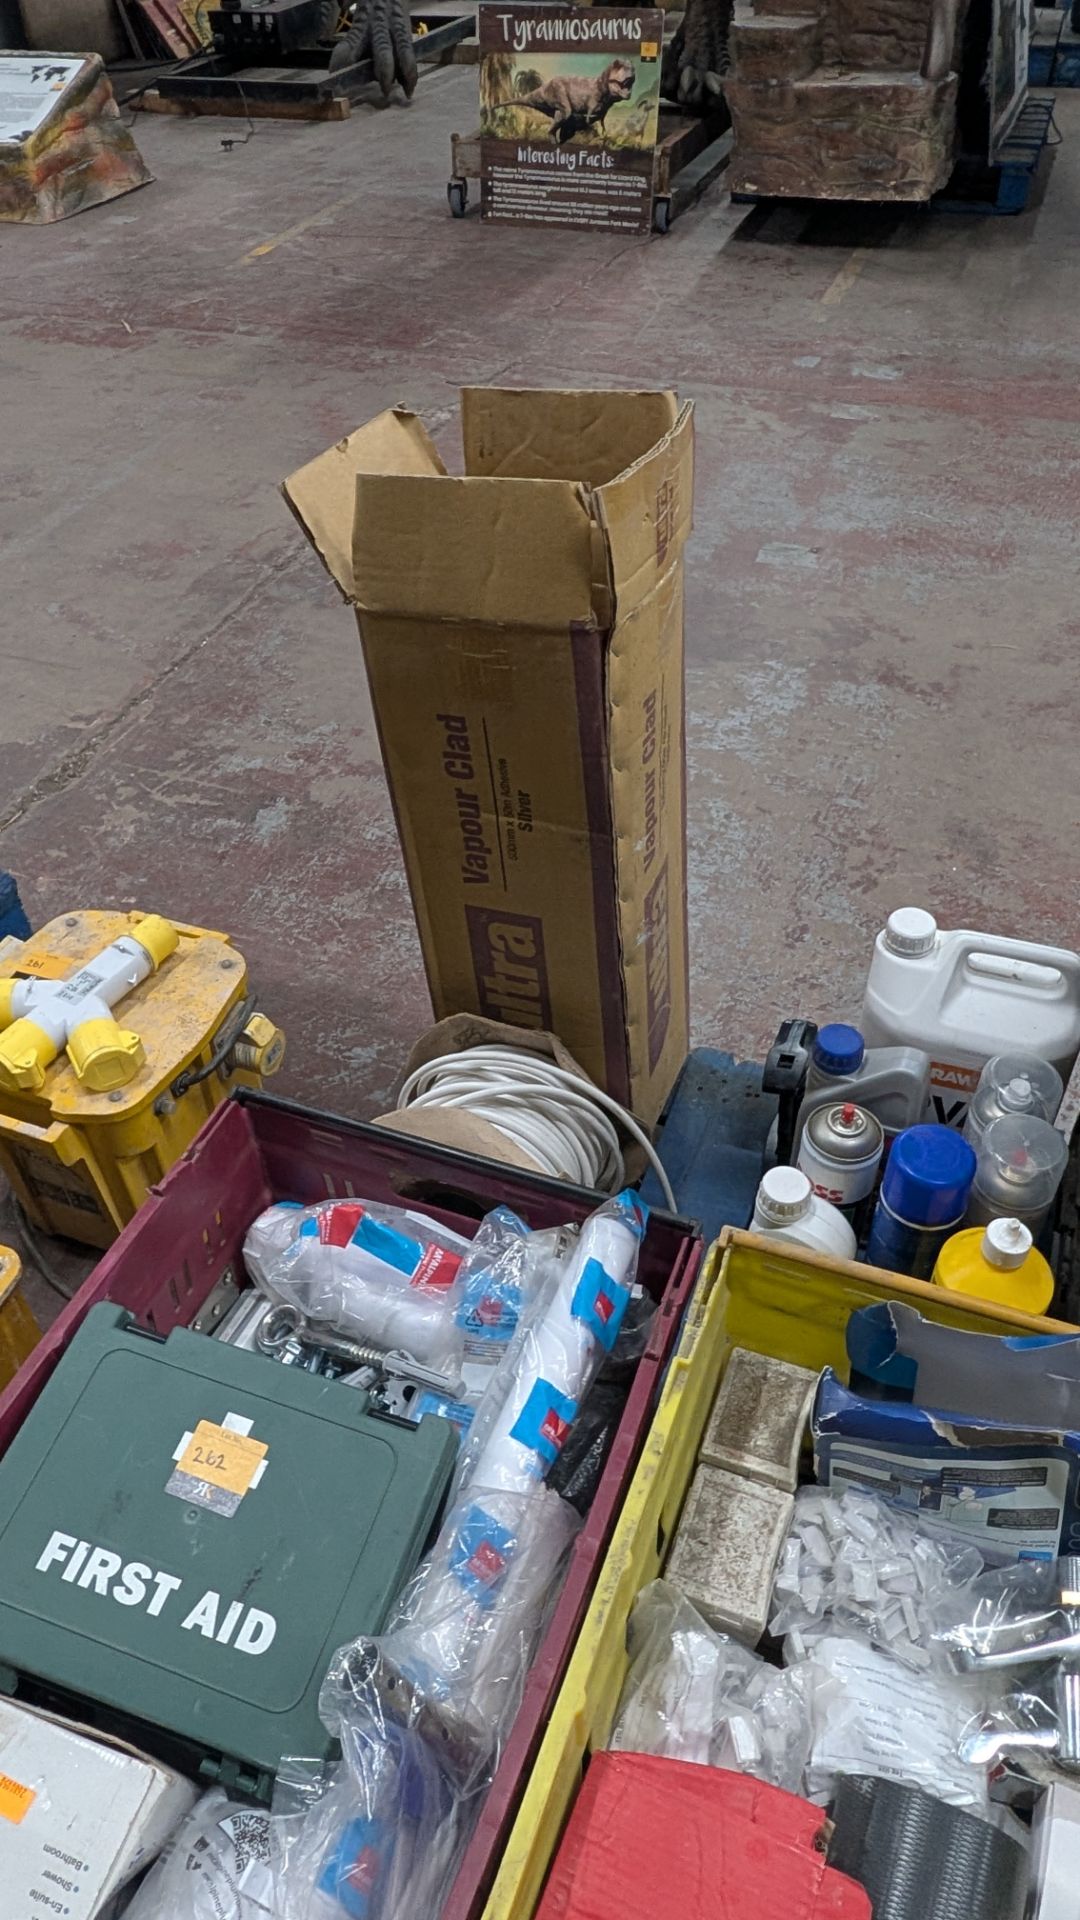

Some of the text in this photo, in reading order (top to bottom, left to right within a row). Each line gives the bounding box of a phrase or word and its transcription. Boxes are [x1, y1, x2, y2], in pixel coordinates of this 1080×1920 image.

[496, 13, 642, 51] Tyrannosaurus
[517, 146, 577, 170] Interesting
[641, 688, 658, 874] Vapour Clad
[436, 713, 490, 887] Vapour Clad
[517, 789, 534, 833] Silver
[192, 1446, 227, 1471] 262
[34, 1530, 277, 1656] FIRST AID
[42, 1843, 83, 1871] Bathroom
[41, 1869, 73, 1892] Shower
[28, 1889, 64, 1914] En-suite
